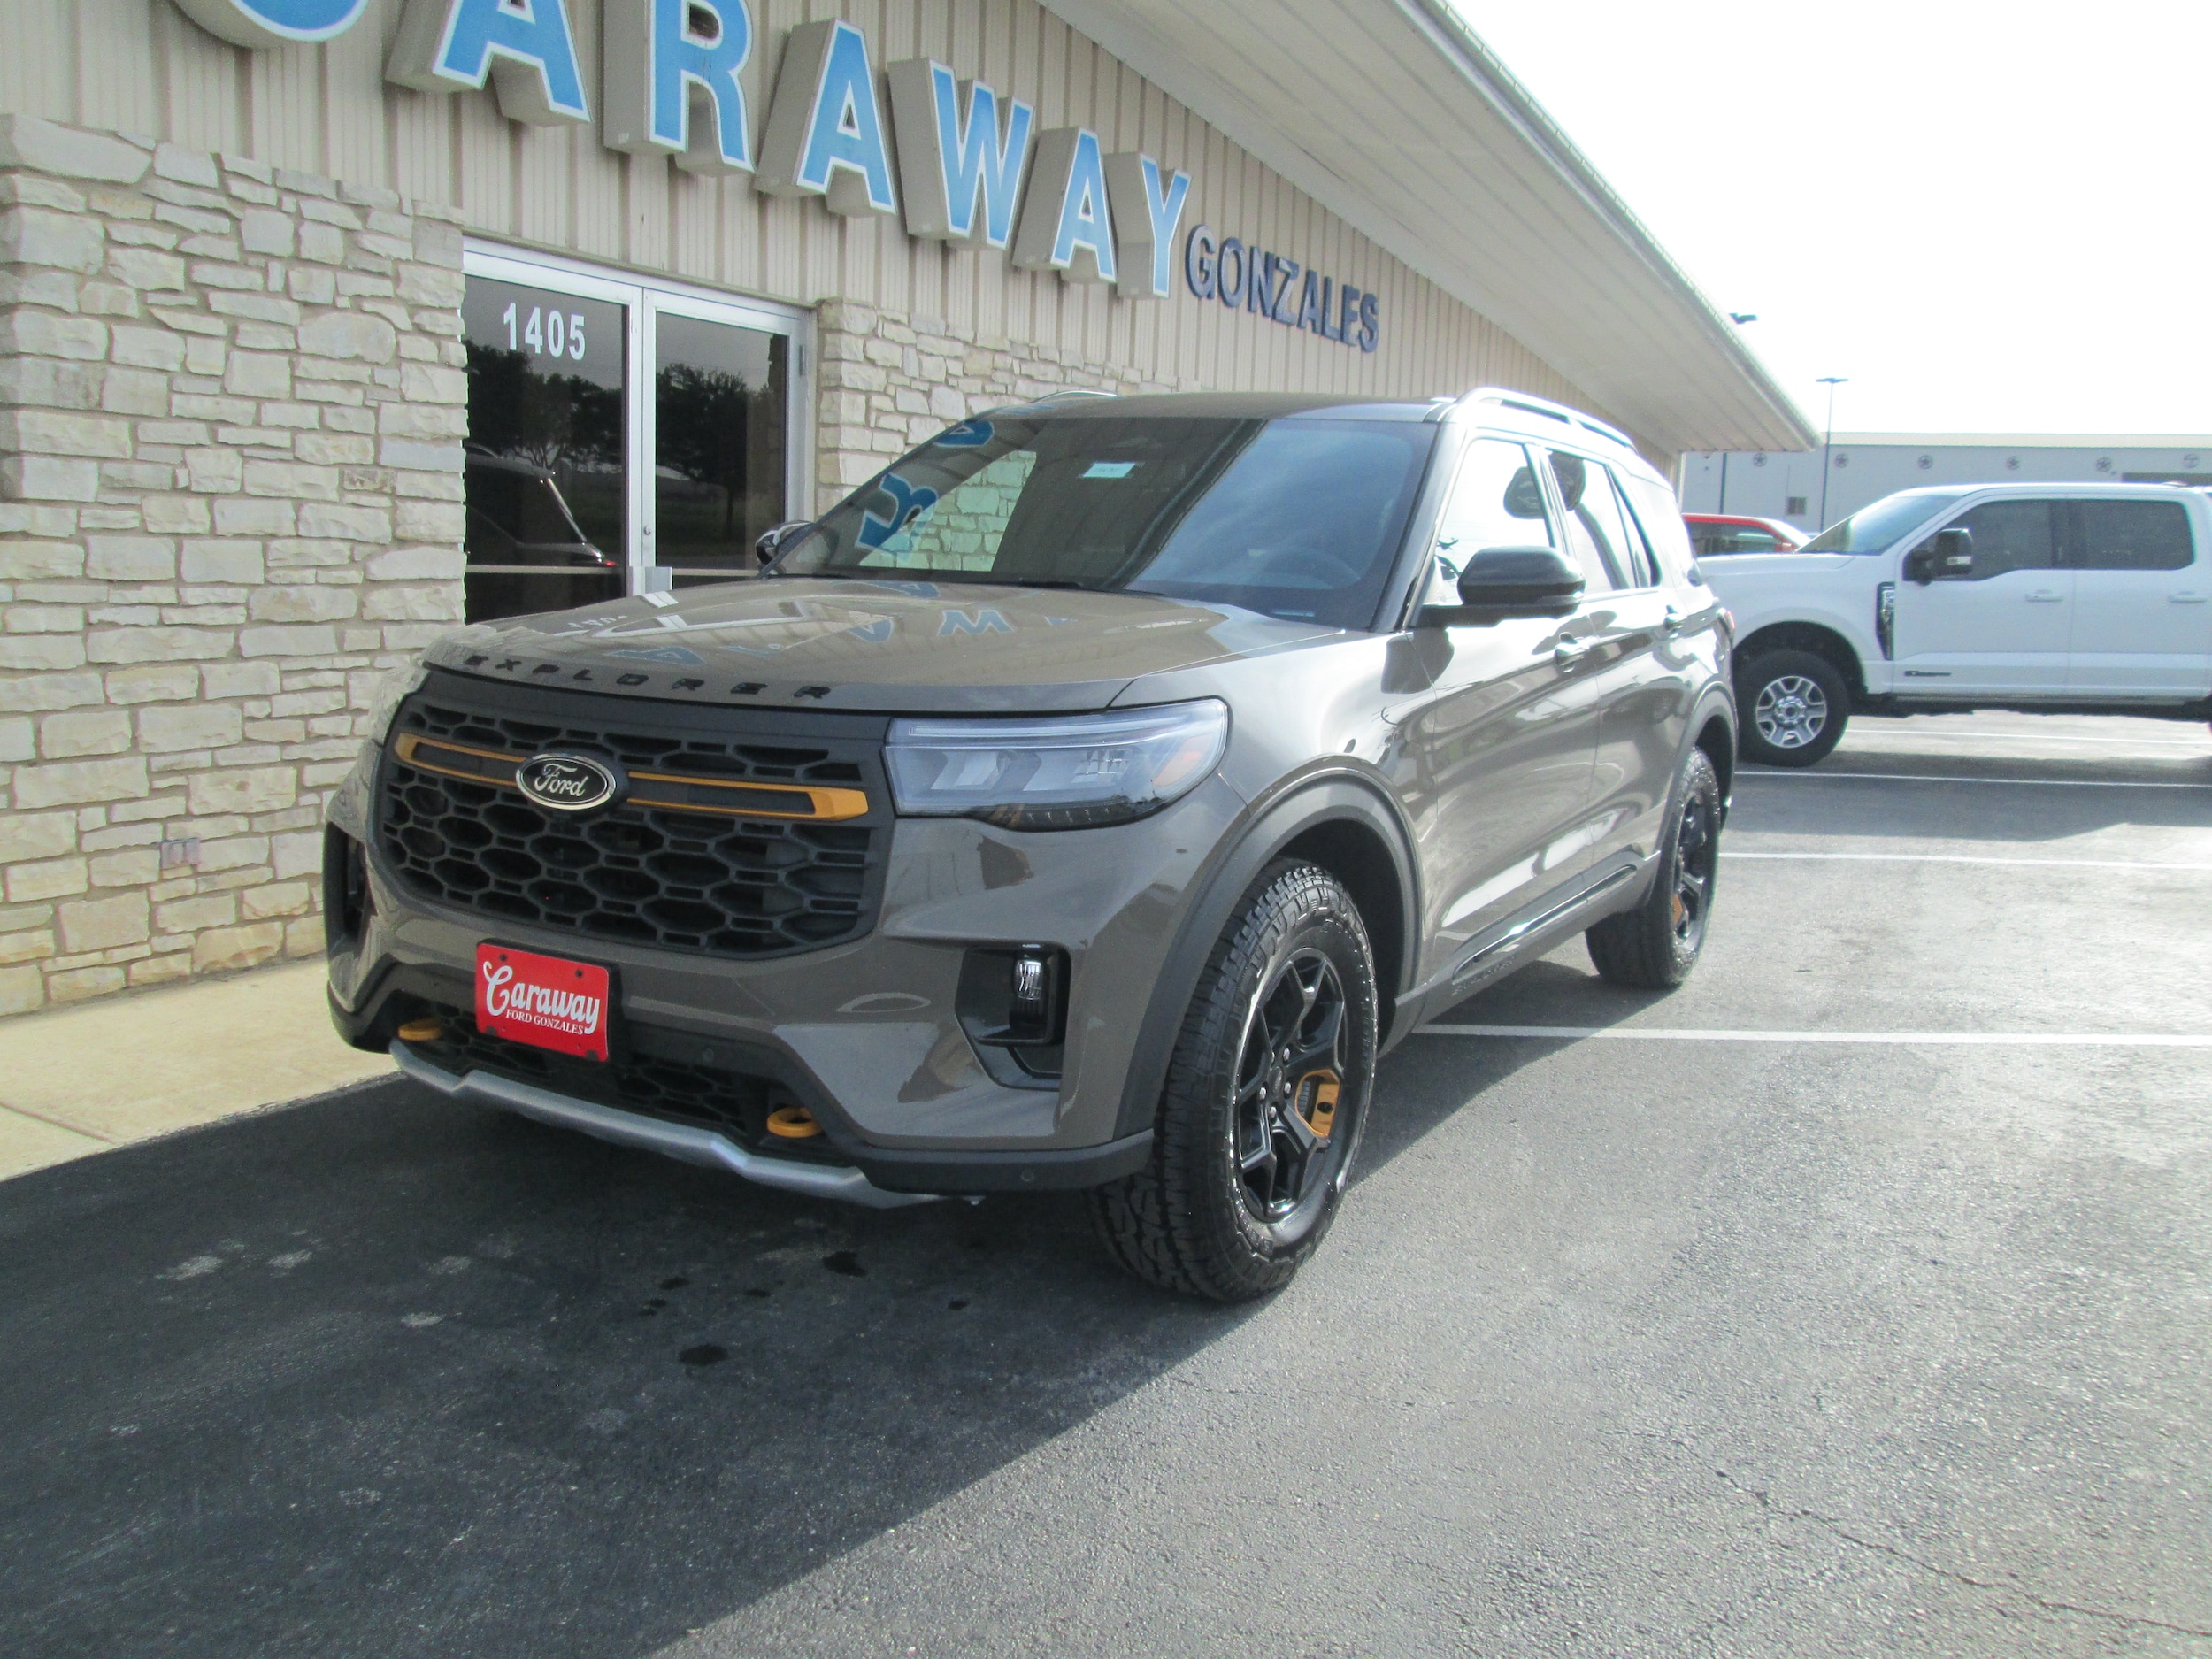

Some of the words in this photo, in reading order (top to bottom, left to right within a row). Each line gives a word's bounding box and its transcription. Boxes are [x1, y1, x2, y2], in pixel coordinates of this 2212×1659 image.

[232, 0, 1192, 298] ARAWAY
[1186, 223, 1379, 353] GONZALES
[503, 303, 586, 361] 1405
[464, 655, 831, 700] EXPLORER
[534, 763, 589, 797] Ford
[483, 961, 601, 1035] Caraway
[505, 1009, 532, 1024] FORD
[534, 1015, 584, 1035] GONZALES
